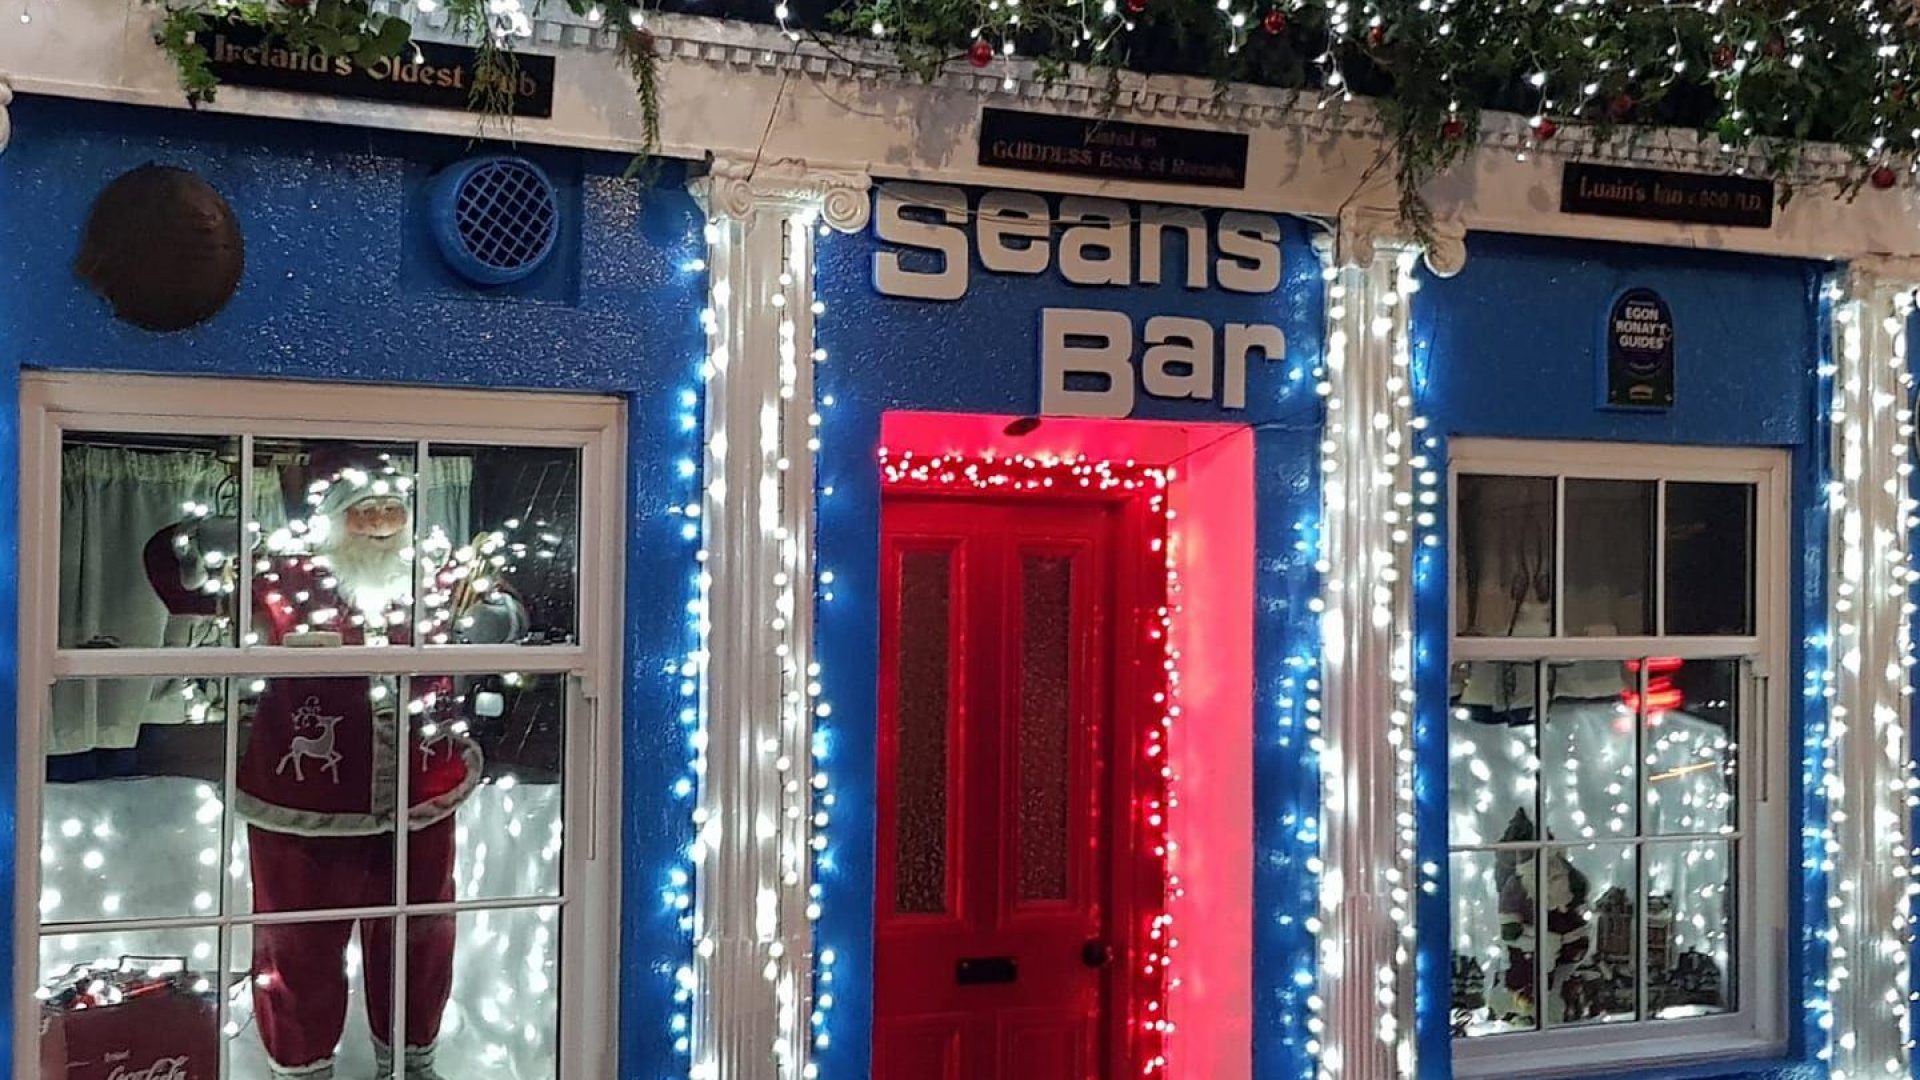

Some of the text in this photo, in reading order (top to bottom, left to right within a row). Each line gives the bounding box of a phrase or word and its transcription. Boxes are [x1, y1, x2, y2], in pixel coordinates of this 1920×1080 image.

[213, 33, 353, 76] Irelands
[366, 54, 464, 89] Oldest
[1099, 151, 1143, 170] Book
[1578, 175, 1646, 202] Luain's
[1652, 181, 1683, 205] Inn
[873, 182, 1281, 300] Seans
[1625, 307, 1659, 321] EGON
[1619, 335, 1665, 349] GUIDES
[1041, 307, 1286, 418] Bar
